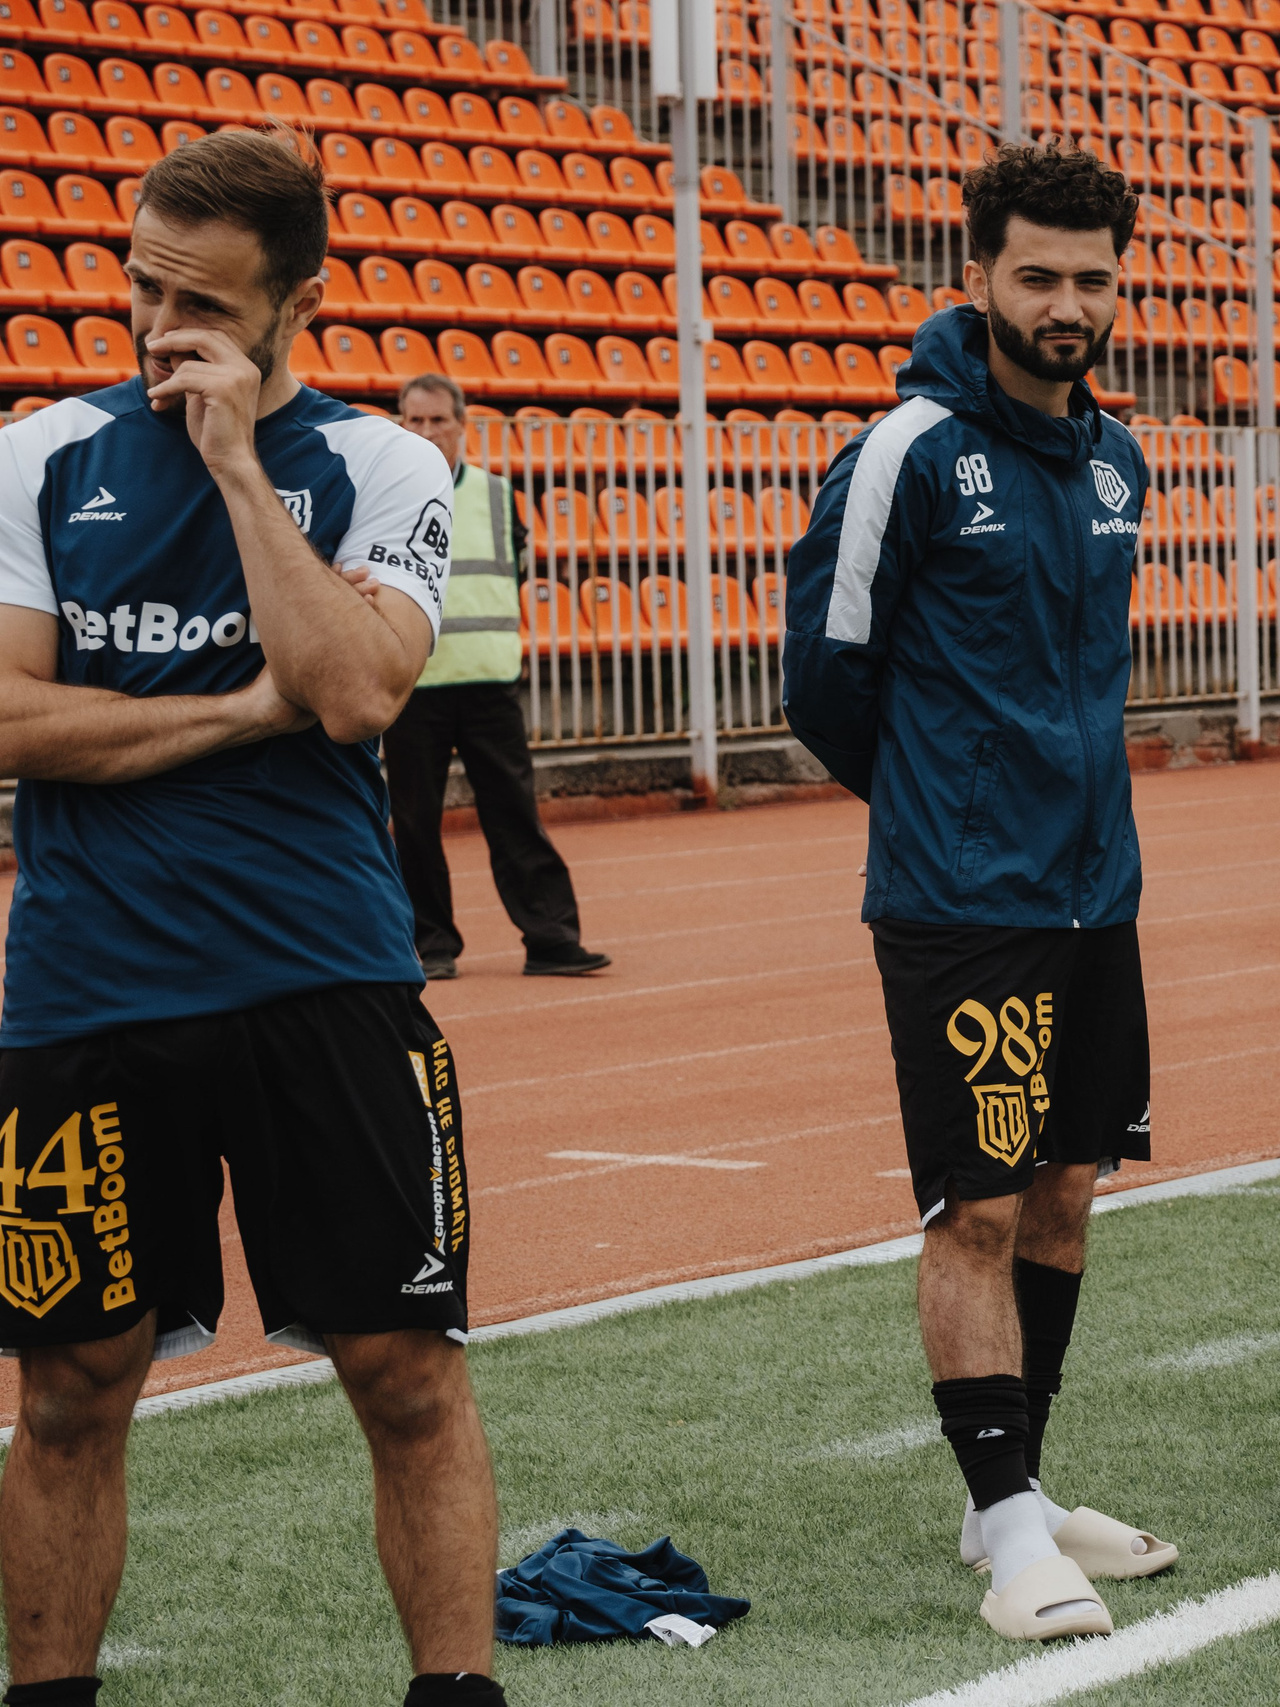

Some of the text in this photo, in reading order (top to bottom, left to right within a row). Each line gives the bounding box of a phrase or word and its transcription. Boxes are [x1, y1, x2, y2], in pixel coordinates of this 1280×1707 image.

[955, 453, 993, 496] 98
[68, 511, 127, 523] DEMIX
[422, 516, 449, 560] BB
[960, 523, 1006, 535] DEMIX
[1092, 517, 1138, 535] BetBoo
[947, 996, 1038, 1083] 98
[432, 1038, 466, 1252] НАС НЕ СЛОМАТЬ
[90, 1102, 137, 1312] BetBoom
[401, 1280, 453, 1294] DEMIX
